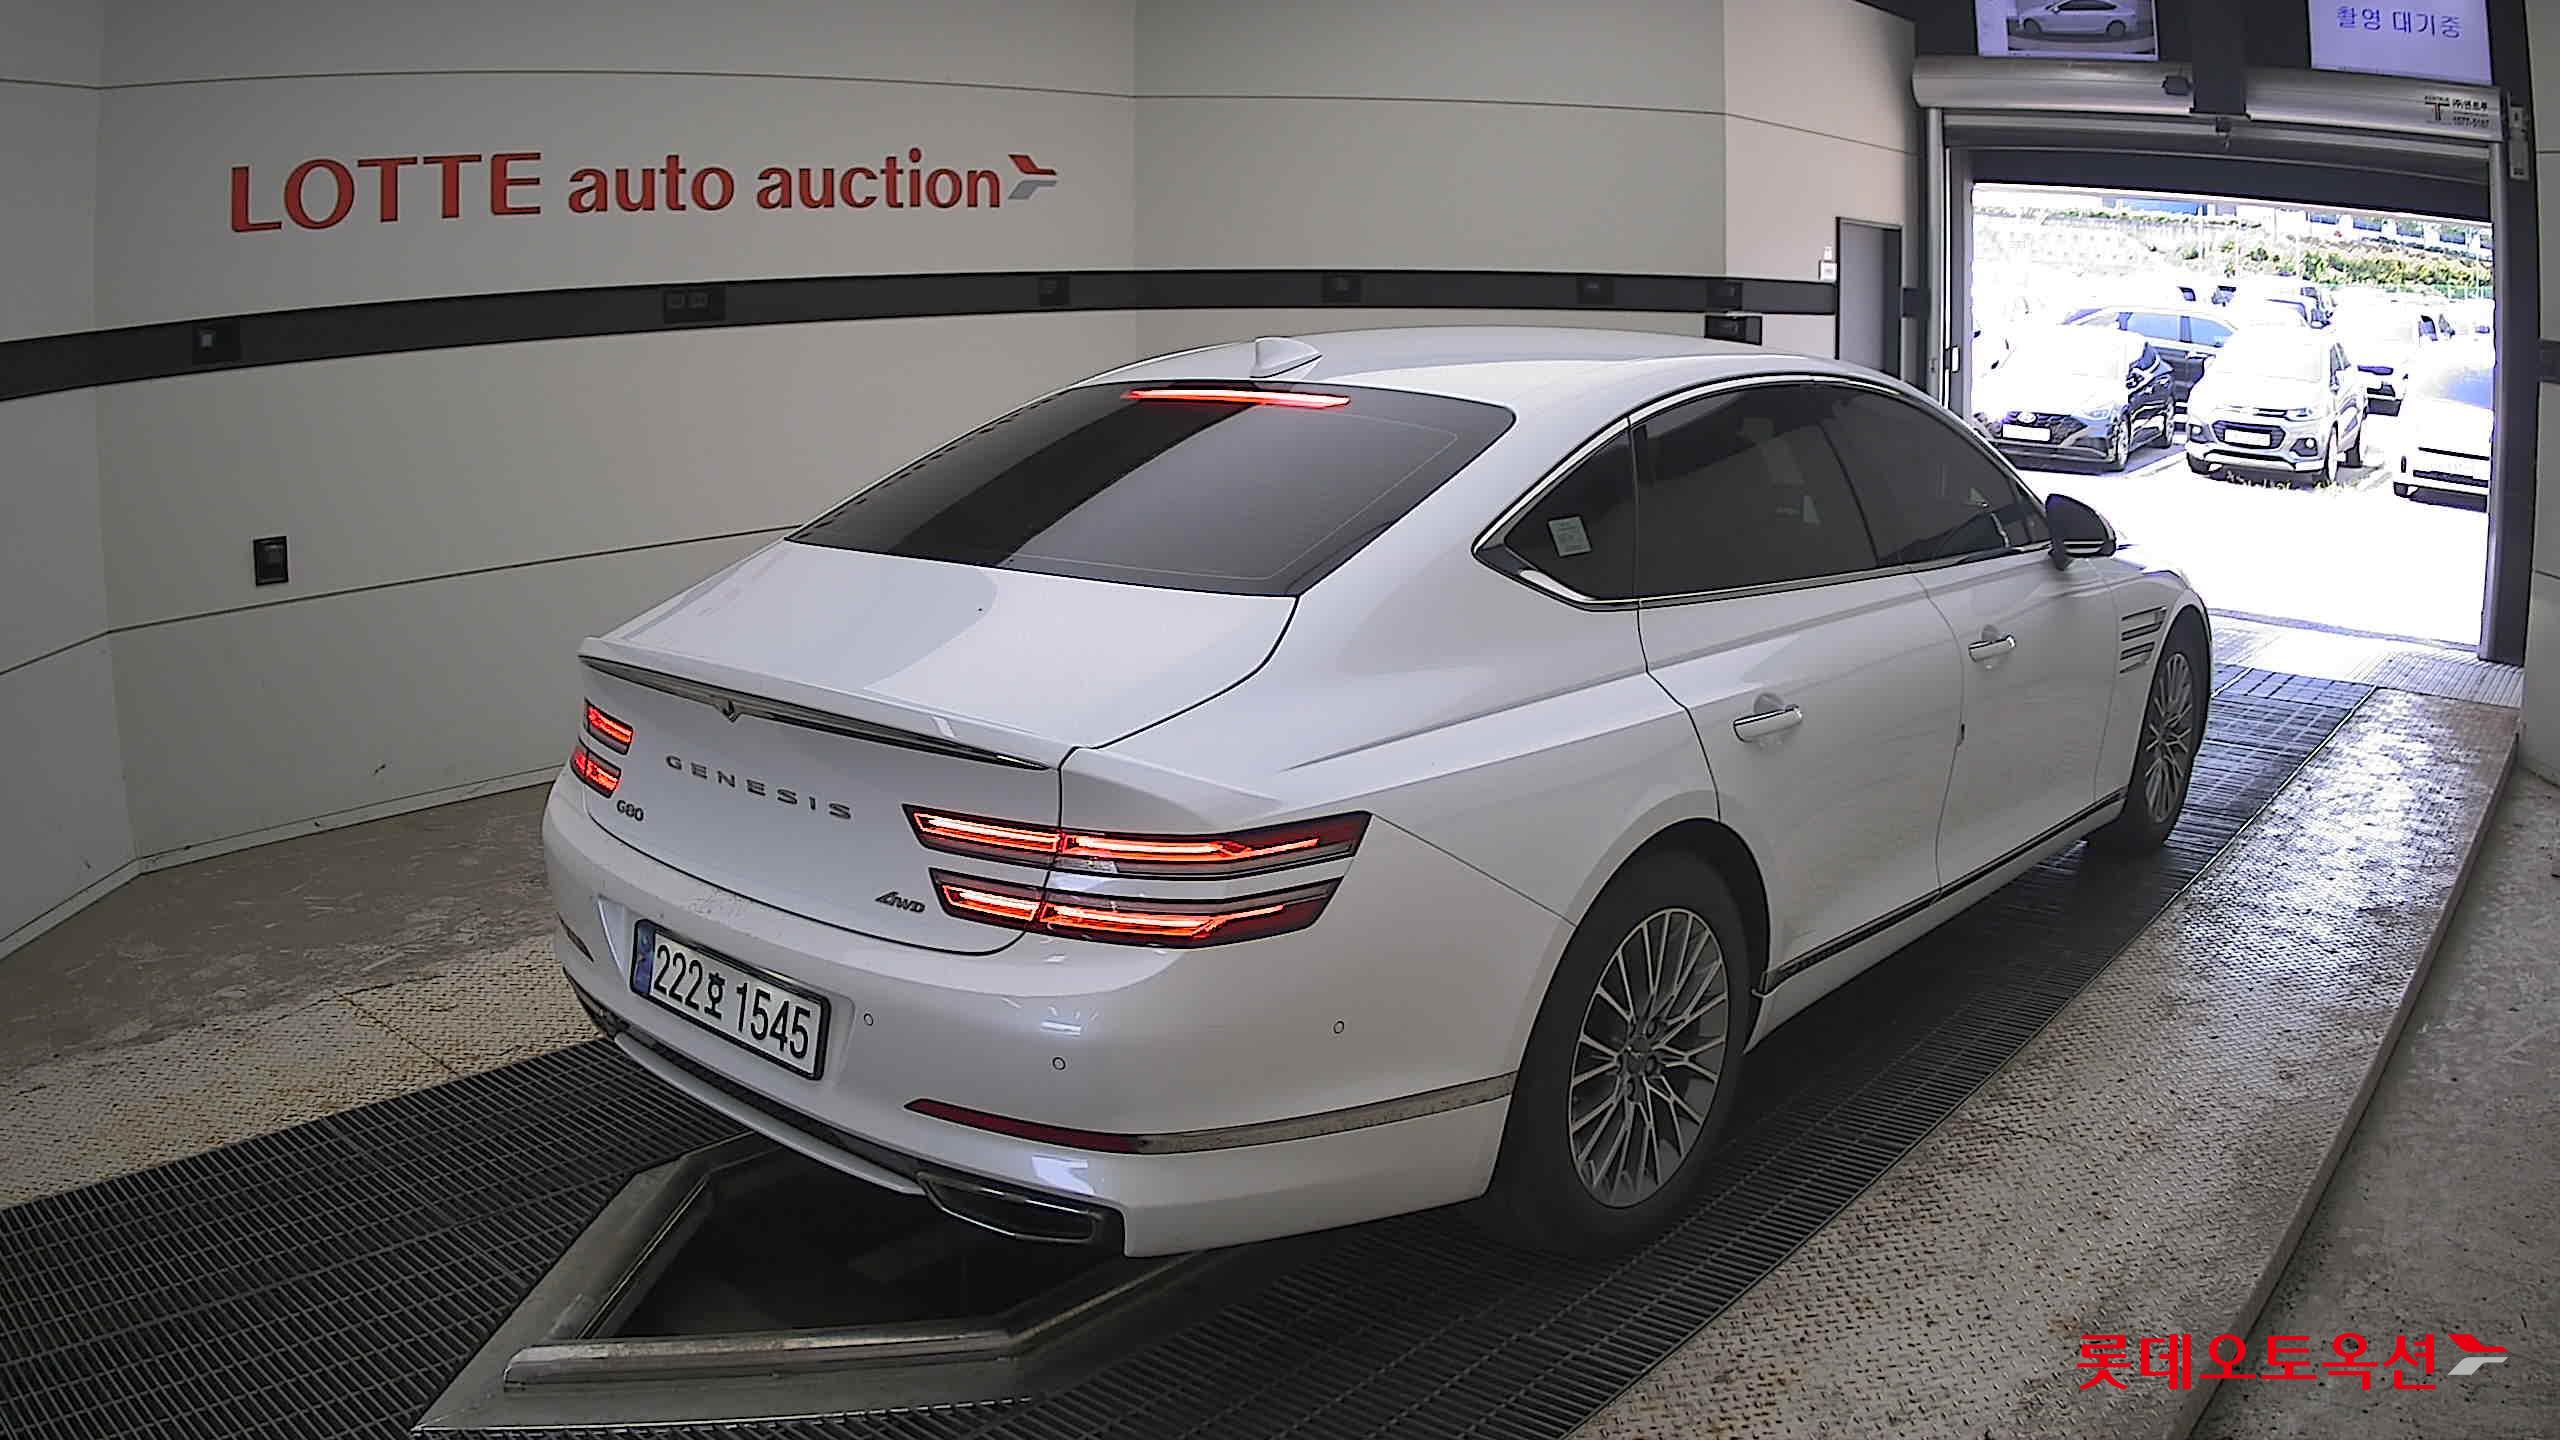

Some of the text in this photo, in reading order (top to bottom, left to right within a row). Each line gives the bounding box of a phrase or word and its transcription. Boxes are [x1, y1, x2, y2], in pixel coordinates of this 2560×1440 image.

[2337, 6, 2461, 39] 촬영 대기중
[231, 148, 1001, 233] LOTTE auto auction
[616, 799, 645, 822] G80
[665, 755, 852, 820] GENESIS
[653, 944, 811, 1059] 222호 1545
